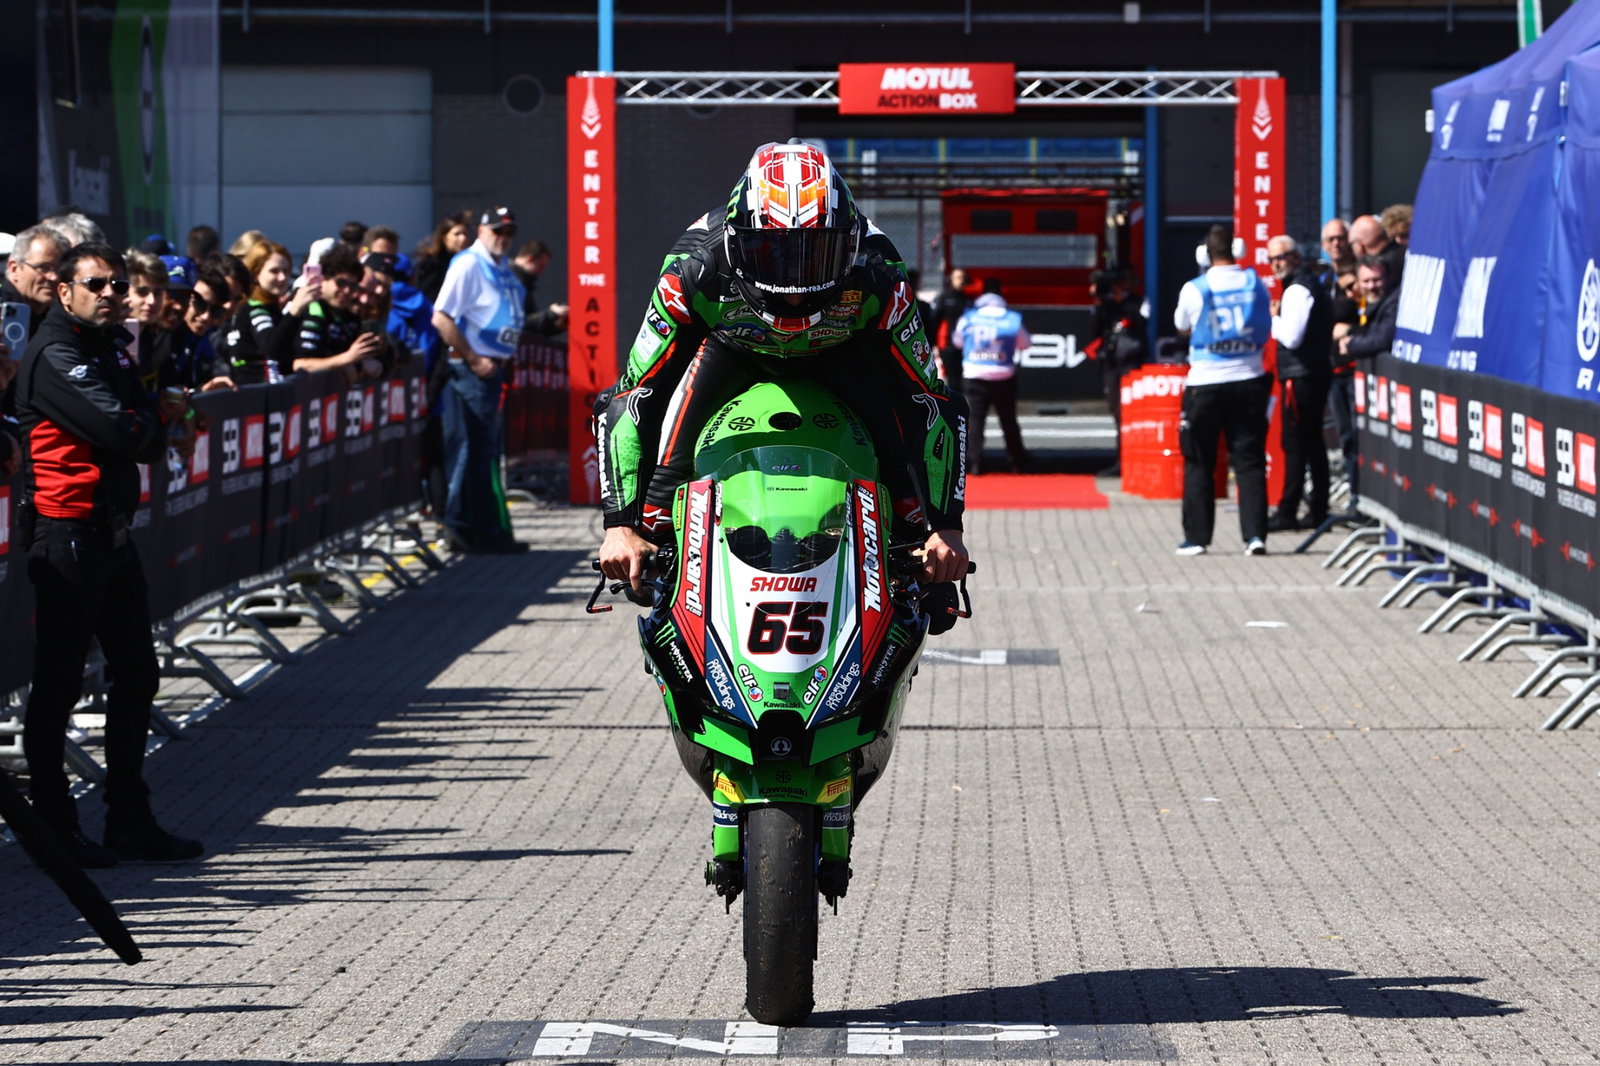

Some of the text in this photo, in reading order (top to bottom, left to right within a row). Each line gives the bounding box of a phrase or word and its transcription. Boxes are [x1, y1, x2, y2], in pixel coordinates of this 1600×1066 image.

[880, 68, 973, 90] MOTUL
[582, 149, 601, 264] ENTER
[1254, 151, 1271, 265] ENTER
[578, 274, 606, 287] THE
[755, 280, 836, 295] www.jonathan-rea.com
[728, 326, 752, 337] elf
[901, 316, 919, 342] elf
[597, 411, 611, 500] Kawasaki
[954, 415, 967, 502] Kawasaki
[750, 577, 818, 592] SHOWA
[747, 601, 829, 655] 65
[669, 641, 694, 682] MONSTER
[872, 643, 897, 685] MONSTER
[706, 659, 736, 710] mouldings
[737, 664, 757, 692] elf
[803, 679, 821, 705] elf
[829, 661, 860, 711] mouldings
[763, 701, 801, 709] Kawasaki
[759, 786, 808, 797] Kawasaki
